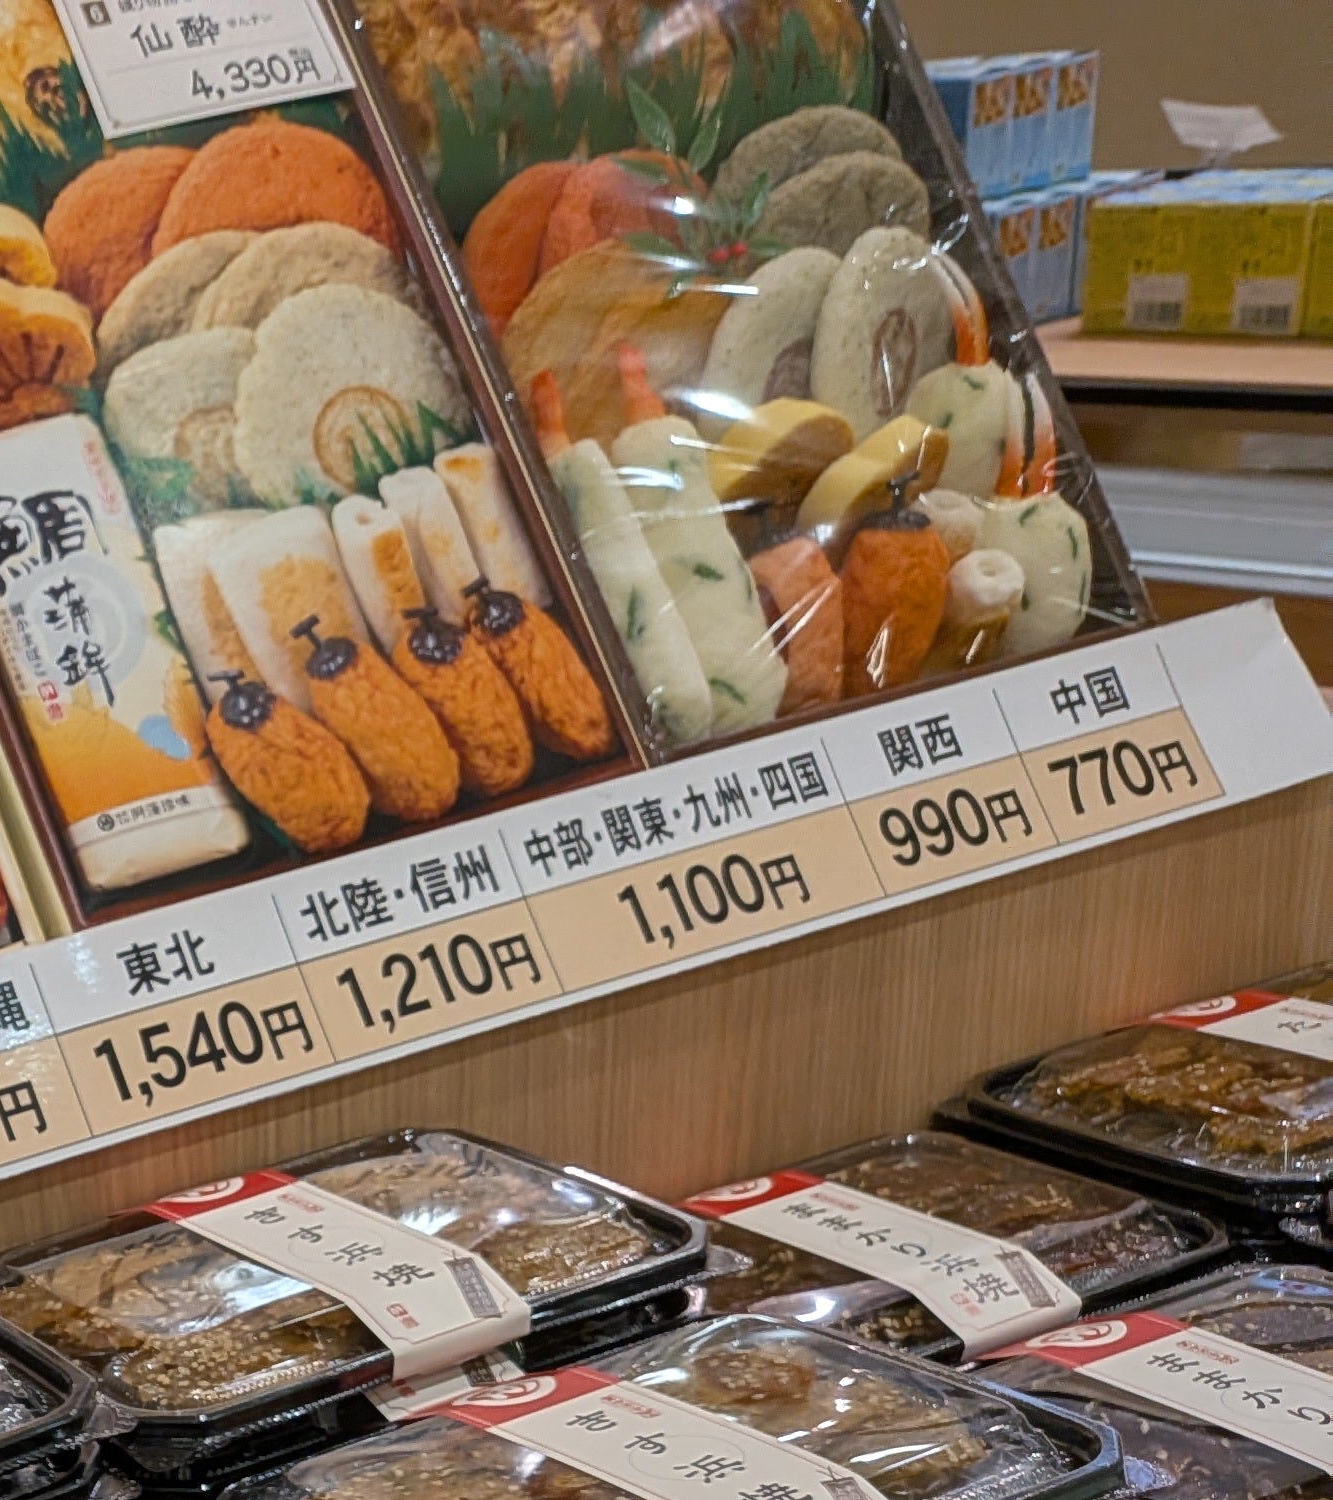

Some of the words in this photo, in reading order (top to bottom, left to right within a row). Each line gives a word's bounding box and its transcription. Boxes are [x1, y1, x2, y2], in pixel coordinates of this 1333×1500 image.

[190, 54, 322, 101] 4,330円
[1051, 667, 1131, 727] 中国
[876, 714, 965, 775] 関西
[1048, 740, 1199, 817] 770円
[879, 787, 1036, 868] 990円
[300, 845, 499, 941] 北陸・信州
[617, 850, 812, 948] 1,100円
[116, 931, 215, 1000] 東北
[335, 928, 544, 1037] 1,210円
[91, 1000, 314, 1107] 1,540円
[1145, 1352, 1333, 1436] ままかり
